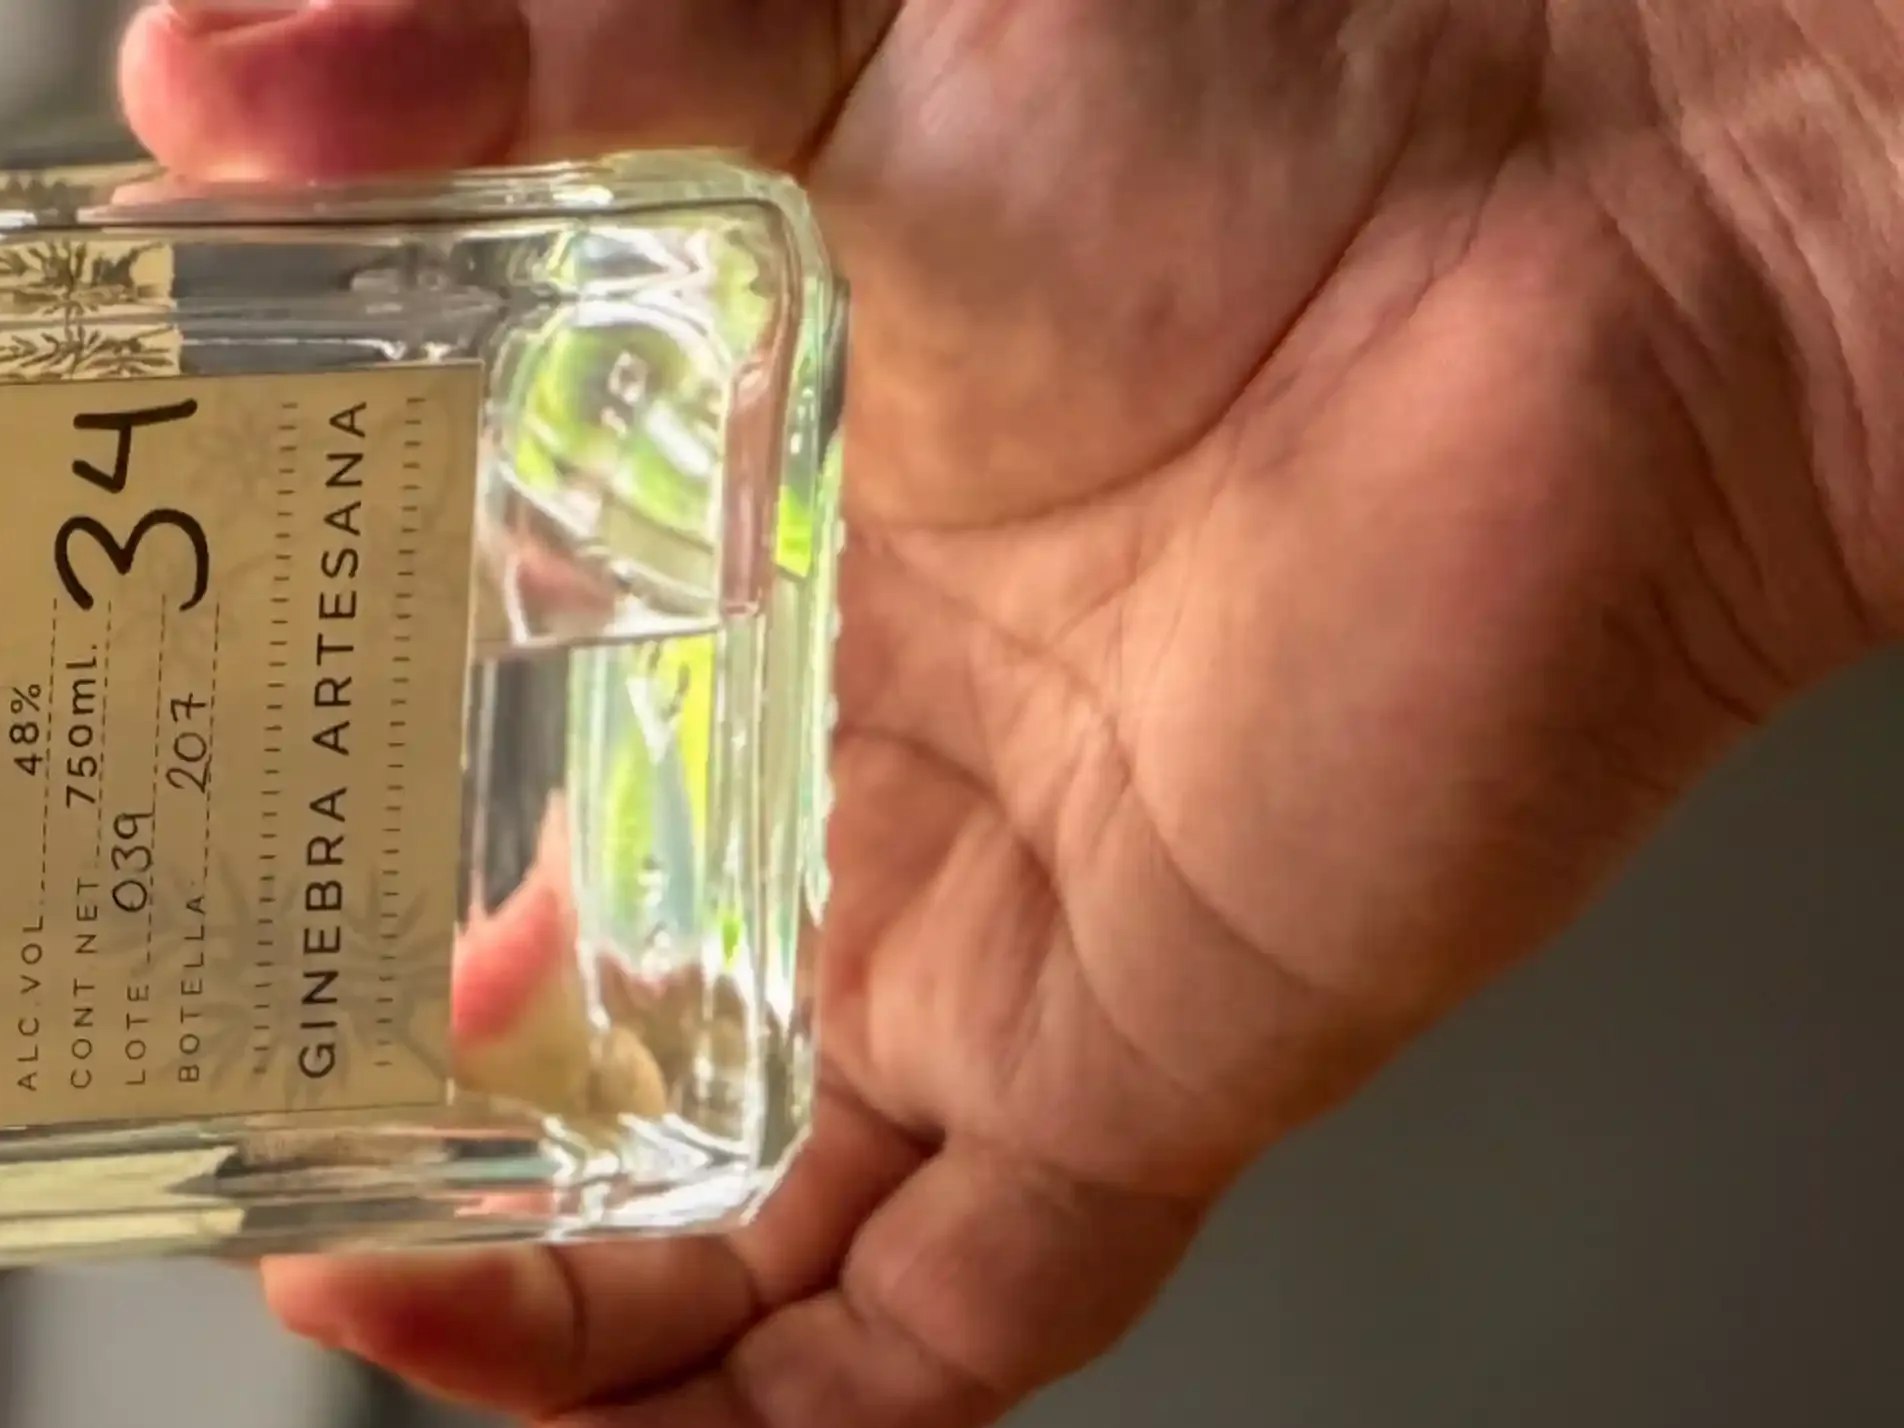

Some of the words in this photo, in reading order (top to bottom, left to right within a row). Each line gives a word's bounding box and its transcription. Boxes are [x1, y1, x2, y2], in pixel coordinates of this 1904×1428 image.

[53, 398, 210, 612] 34
[311, 401, 367, 757] ARTESANA
[8, 683, 44, 777] 48%
[164, 692, 209, 794] 207
[110, 811, 154, 914] 039
[297, 786, 348, 1080] GINEBRA
[124, 984, 150, 1086] LOTE
